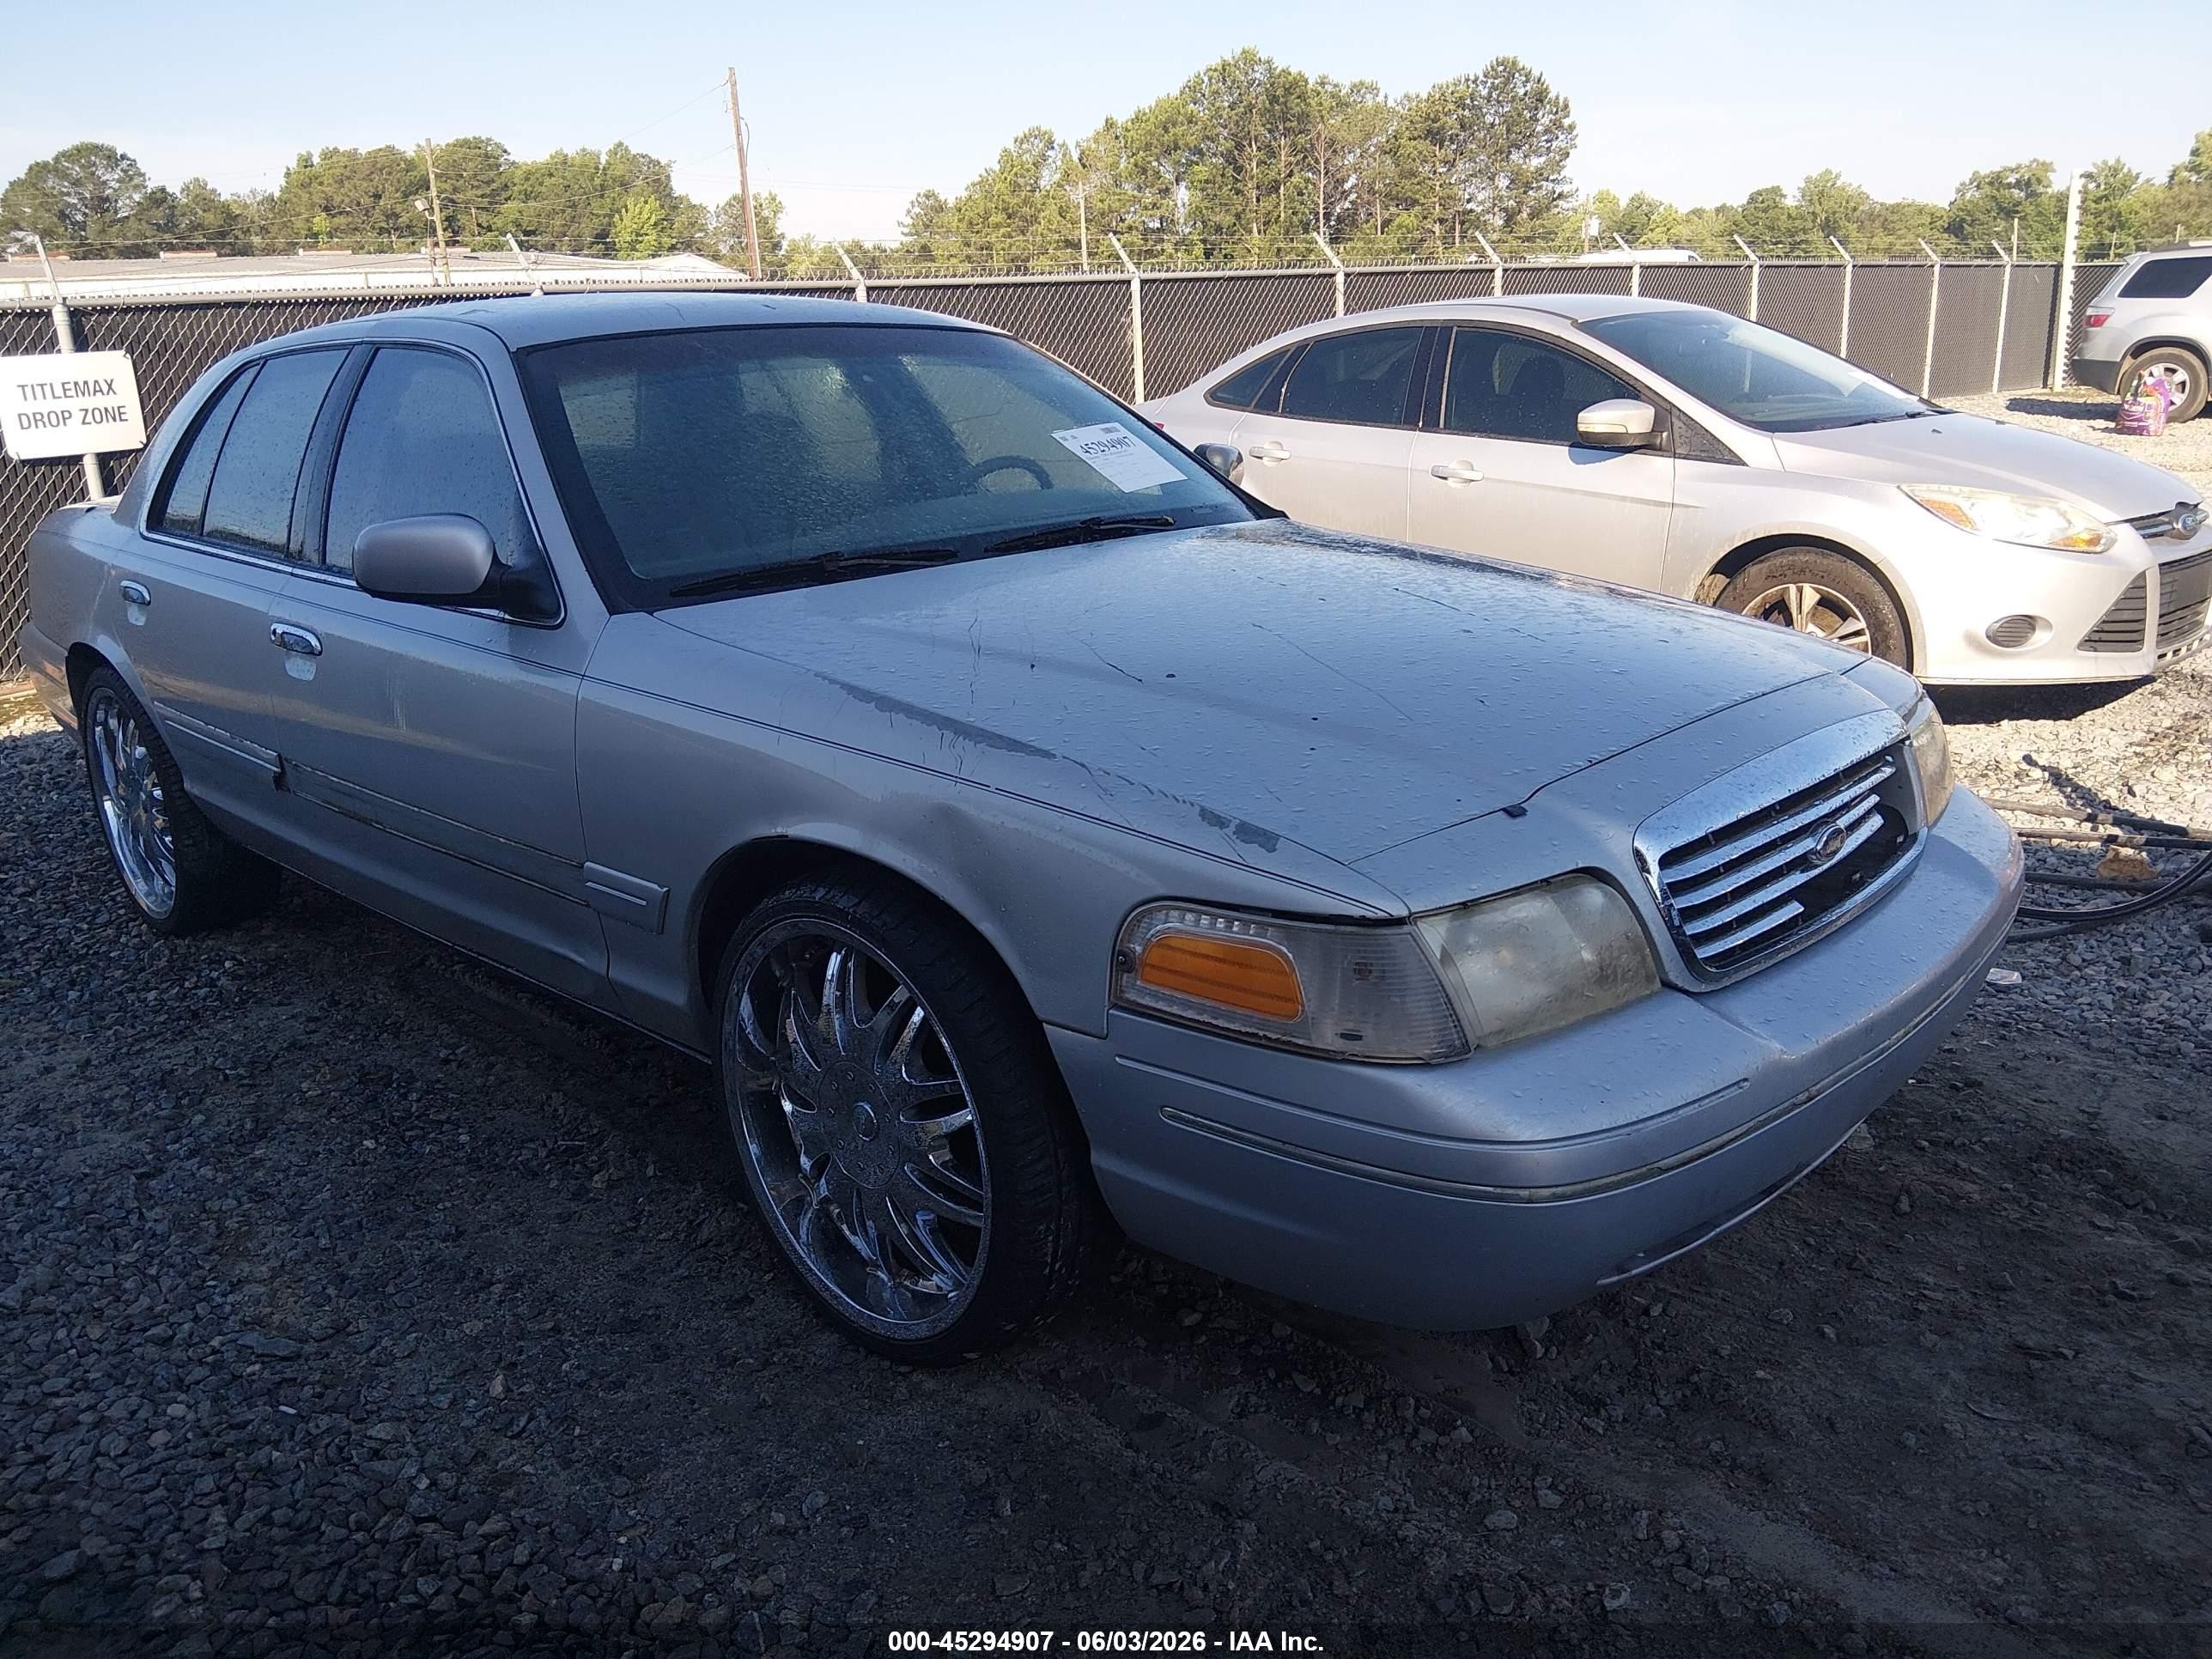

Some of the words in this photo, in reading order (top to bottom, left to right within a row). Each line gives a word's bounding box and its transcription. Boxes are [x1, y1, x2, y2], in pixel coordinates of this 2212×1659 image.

[17, 378, 118, 402] TITLEMAX
[17, 410, 73, 430] DROP
[79, 405, 129, 426] ZONE
[1079, 435, 1137, 456] 45294907
